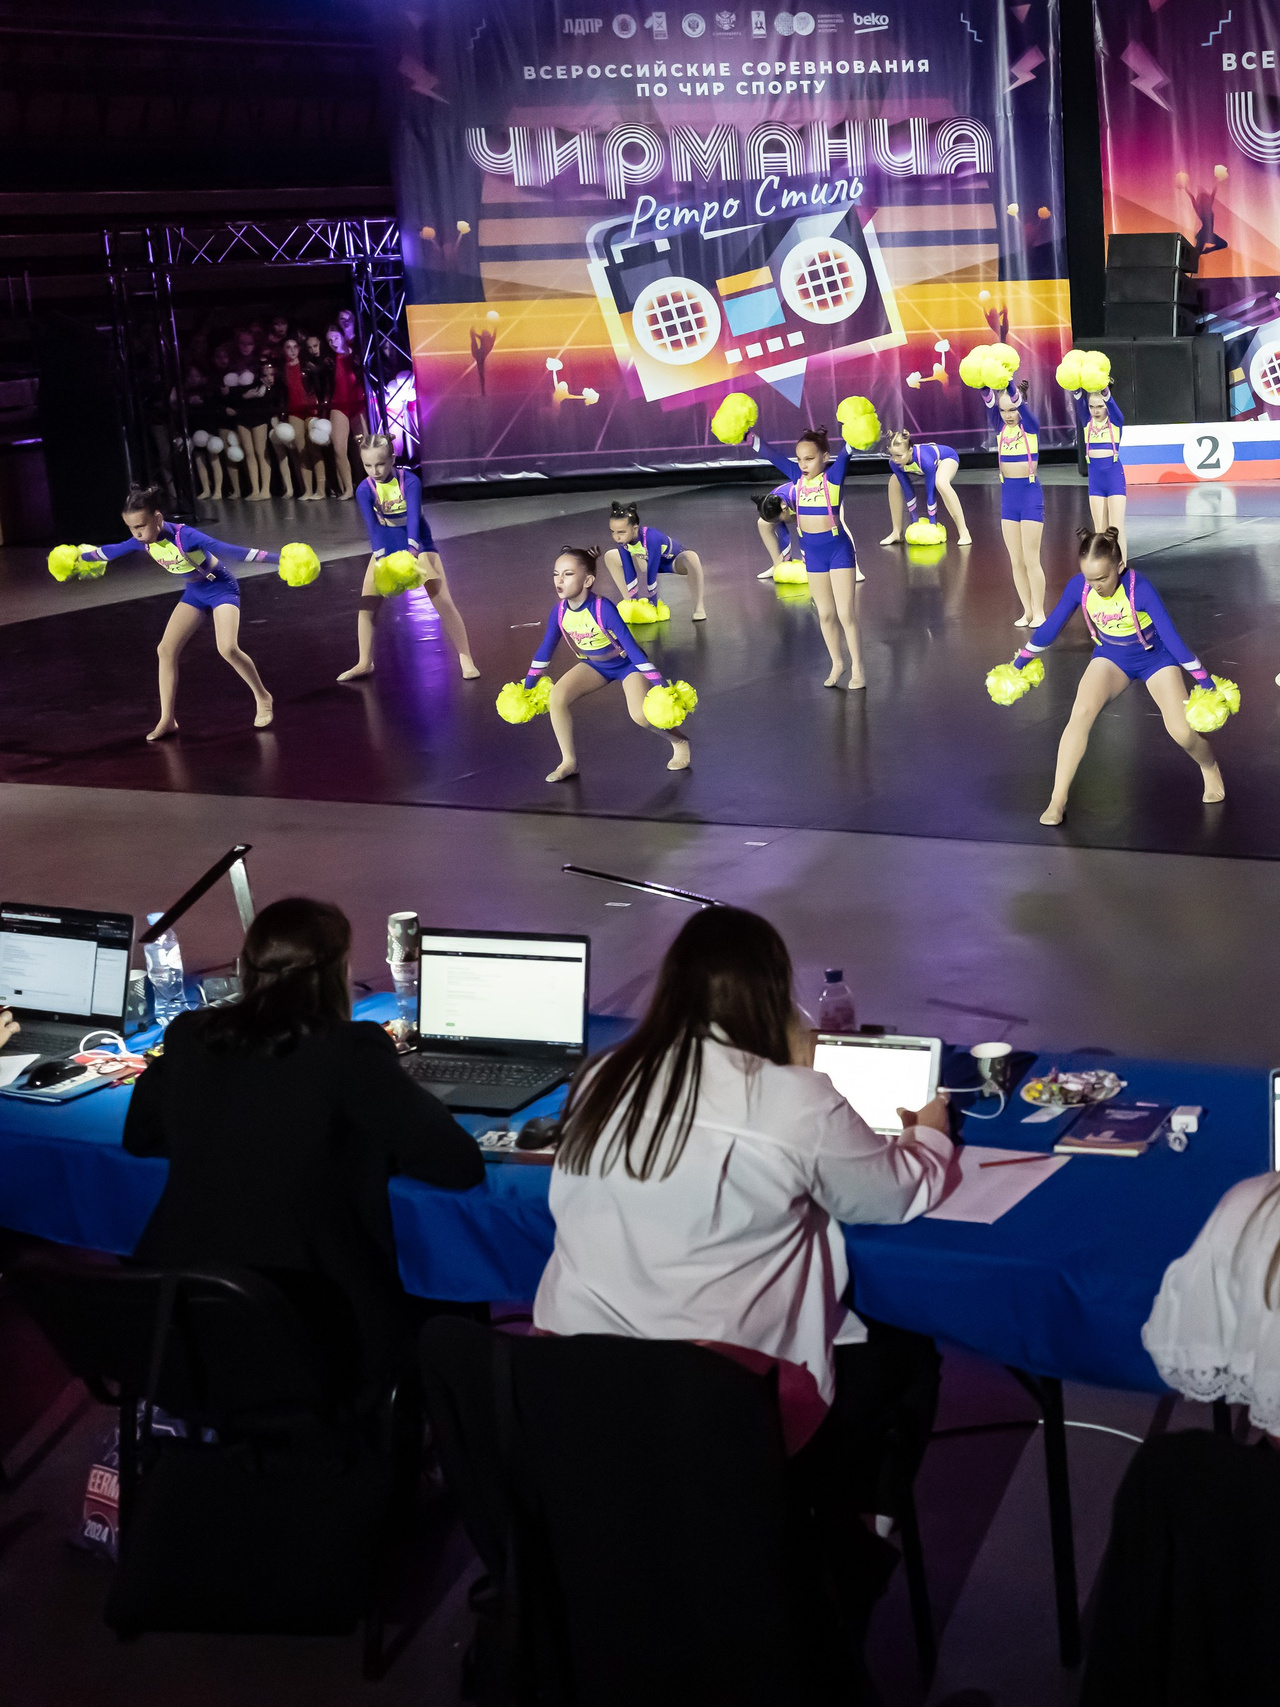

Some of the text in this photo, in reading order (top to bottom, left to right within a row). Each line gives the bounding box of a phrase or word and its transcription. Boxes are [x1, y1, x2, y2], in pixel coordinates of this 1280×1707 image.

[563, 18, 603, 36] ЛДПР
[853, 12, 889, 26] beko
[523, 59, 930, 80] ВСЕРОССИЙСКИЕ СОРЕВНОВАНИЯ
[636, 80, 826, 97] ПО ЧИР СПОРТУ
[630, 175, 864, 239] Ретро Стиль
[1196, 435, 1221, 470] 2
[83, 1519, 110, 1543] 2024
